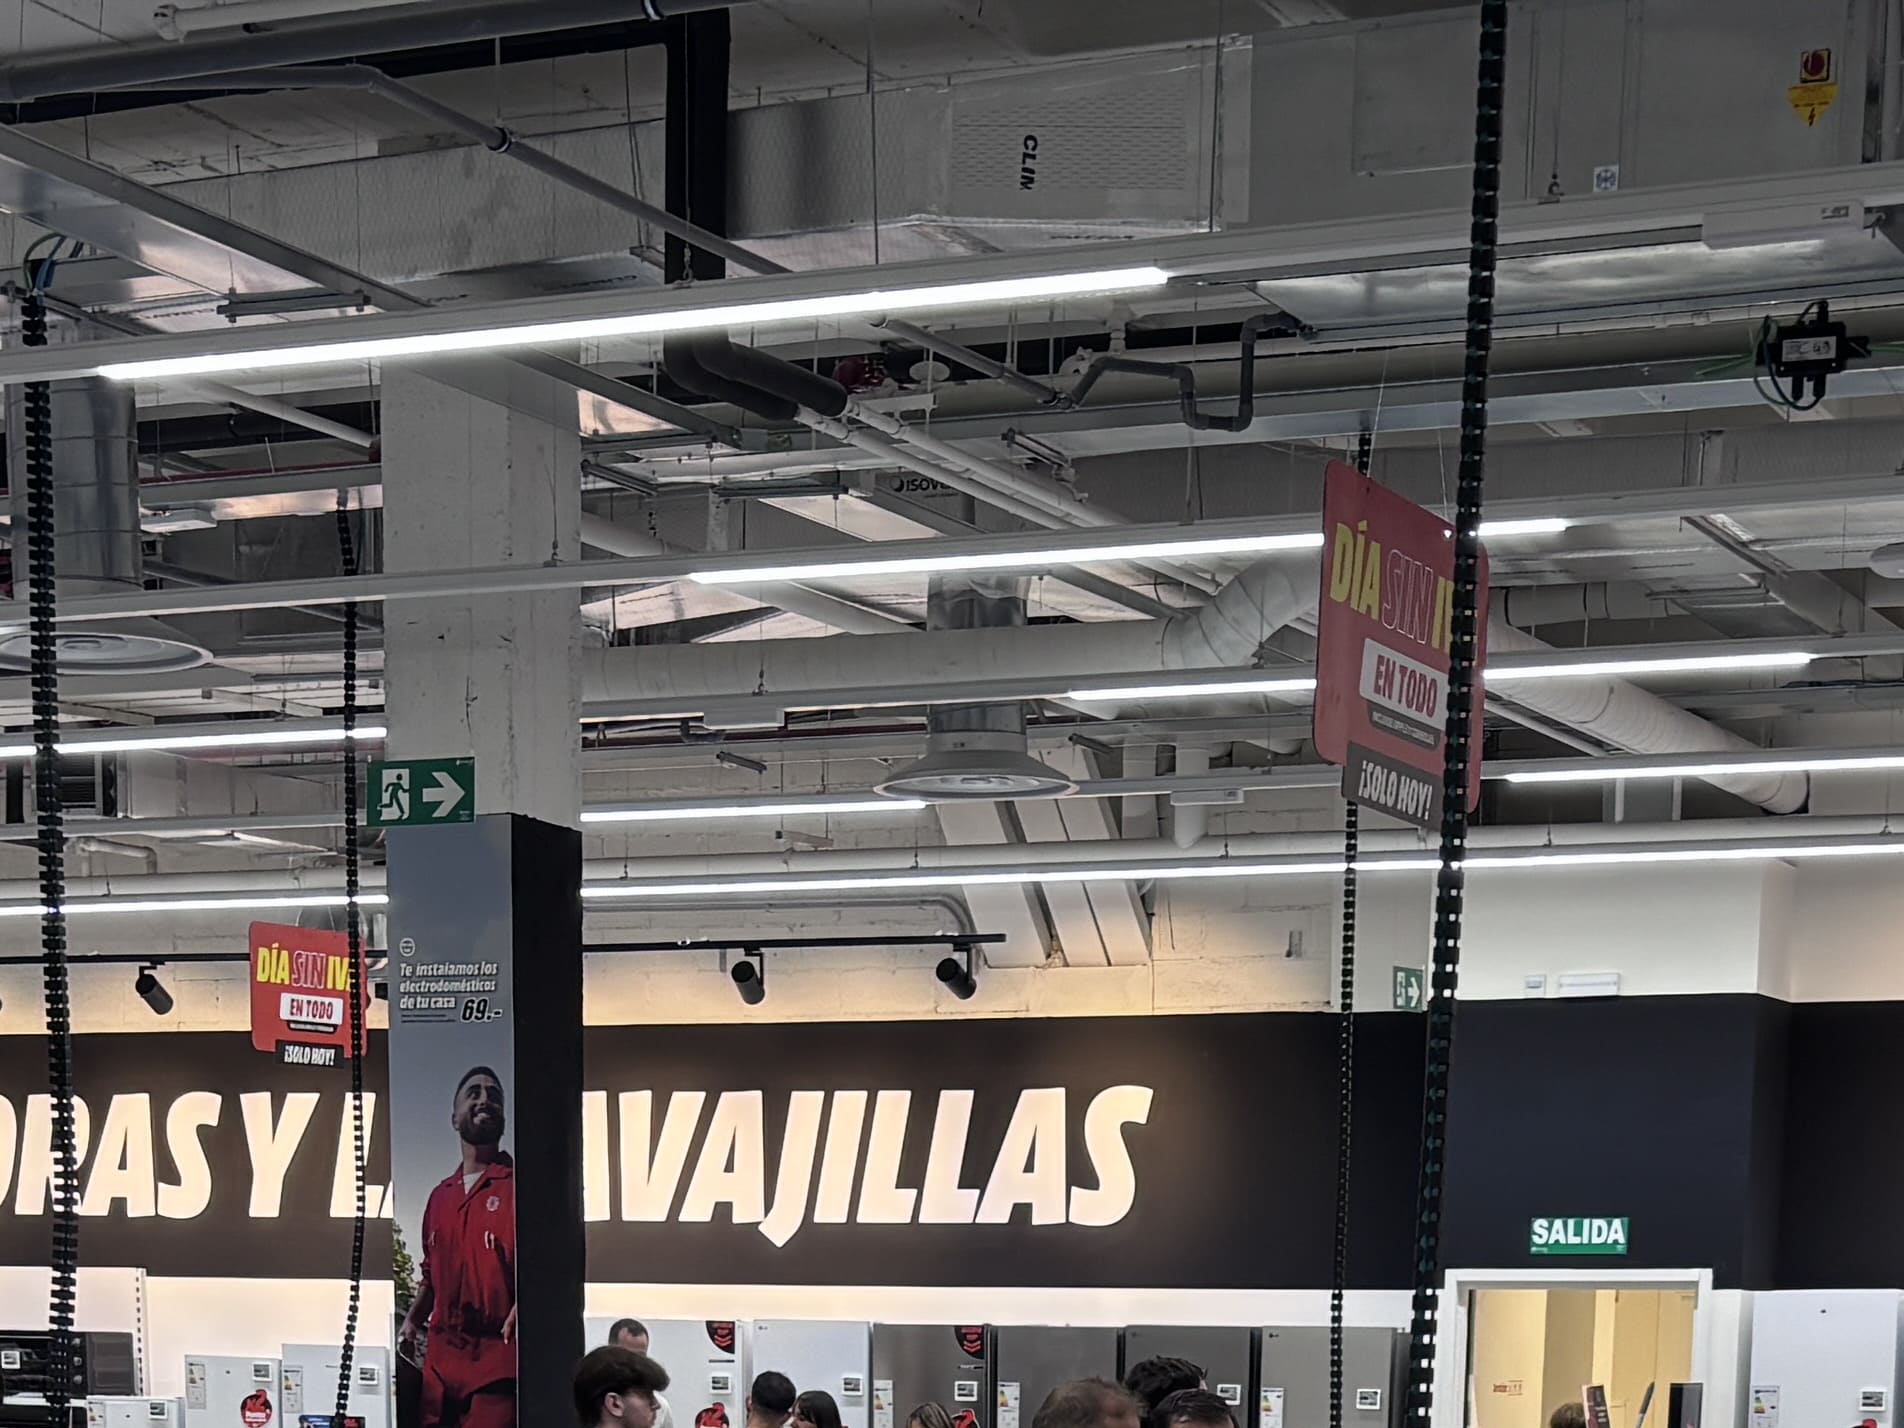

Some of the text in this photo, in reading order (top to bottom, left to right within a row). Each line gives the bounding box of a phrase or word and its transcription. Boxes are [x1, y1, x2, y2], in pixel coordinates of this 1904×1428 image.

[1330, 520, 1433, 645] DÍA SIN
[1374, 654, 1438, 718] EN TODO
[1358, 759, 1433, 821] ¡SOLO HOY!
[256, 943, 327, 989] DÍA SIN
[400, 961, 498, 976] Te instalamos los
[290, 998, 333, 1020] EN TODO
[430, 997, 455, 1009] casa
[240, 1092, 321, 1220] Y
[332, 1085, 1154, 1247] LVAJILLAS
[1532, 1219, 1627, 1246] SALIDA
